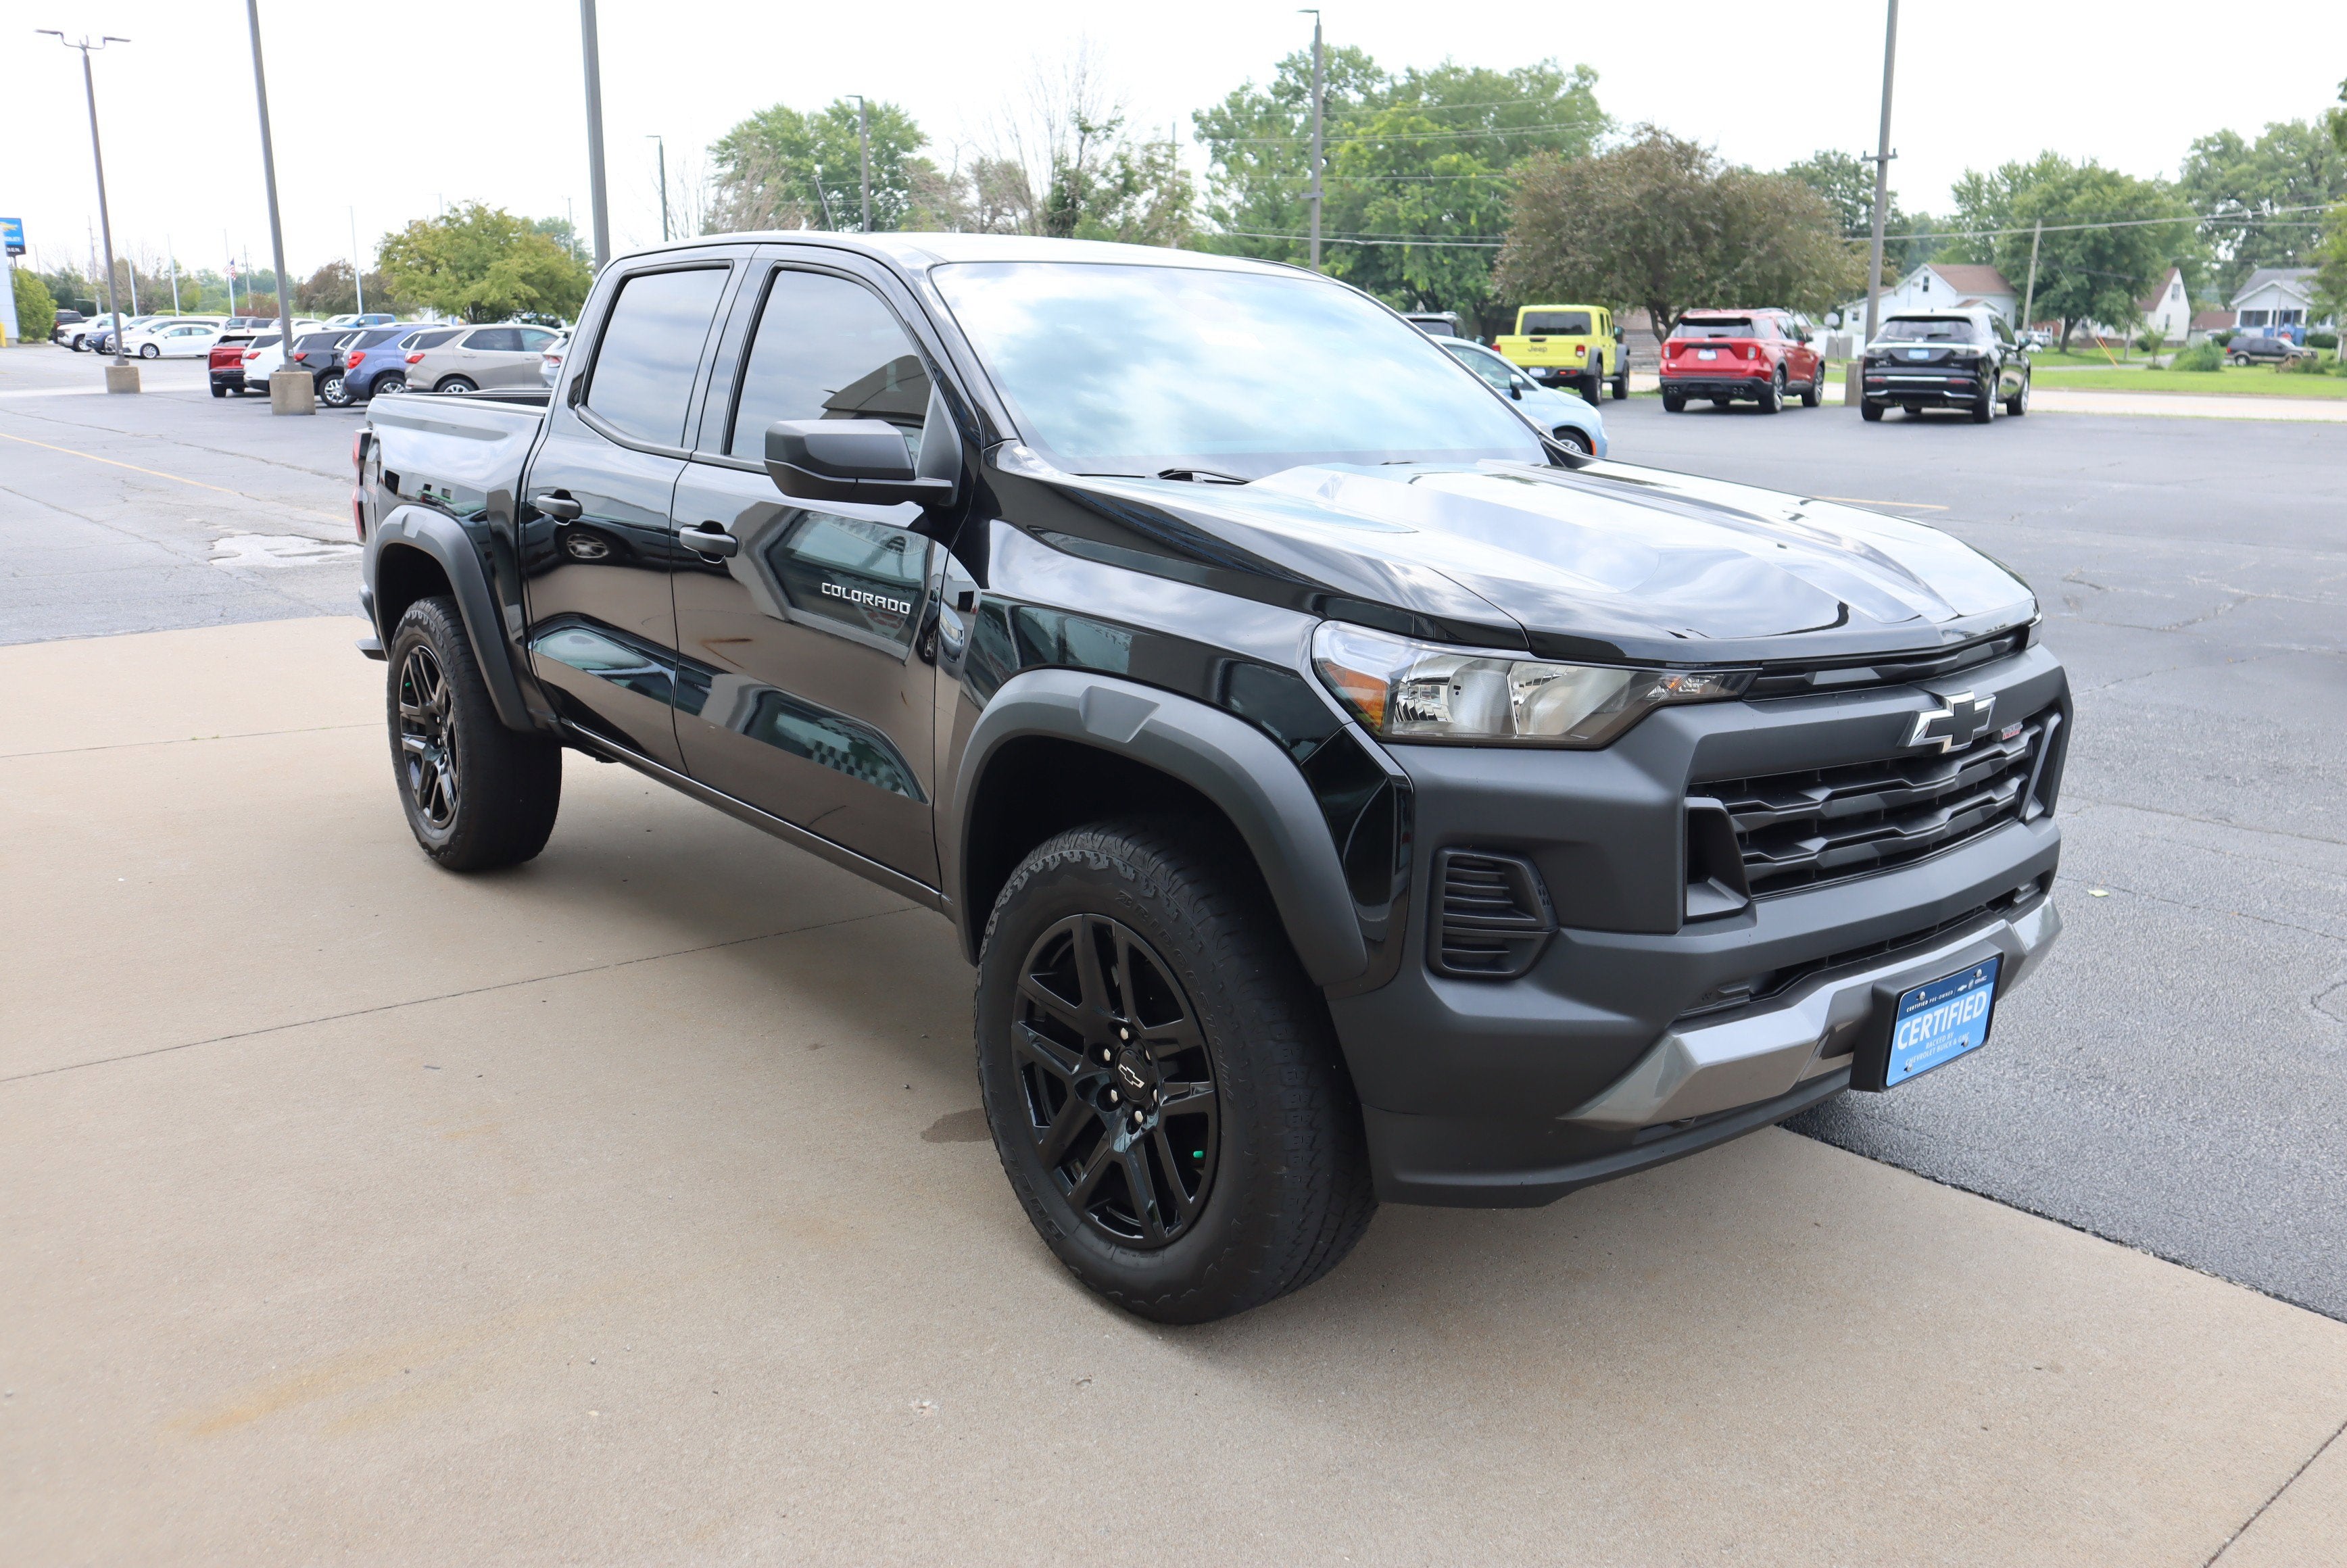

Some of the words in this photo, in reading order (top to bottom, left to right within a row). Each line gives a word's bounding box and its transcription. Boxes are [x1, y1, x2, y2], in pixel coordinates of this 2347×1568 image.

[821, 582, 911, 614] COLORADO
[1975, 976, 1987, 984] GMC
[1906, 1000, 1929, 1012] CERTIFIED
[1929, 990, 1954, 1003] PRE-OWNED
[1897, 991, 1987, 1050] CERTIFIED
[1905, 1048, 1936, 1066] CHEVROLET
[1937, 1041, 1952, 1052] BUICK
